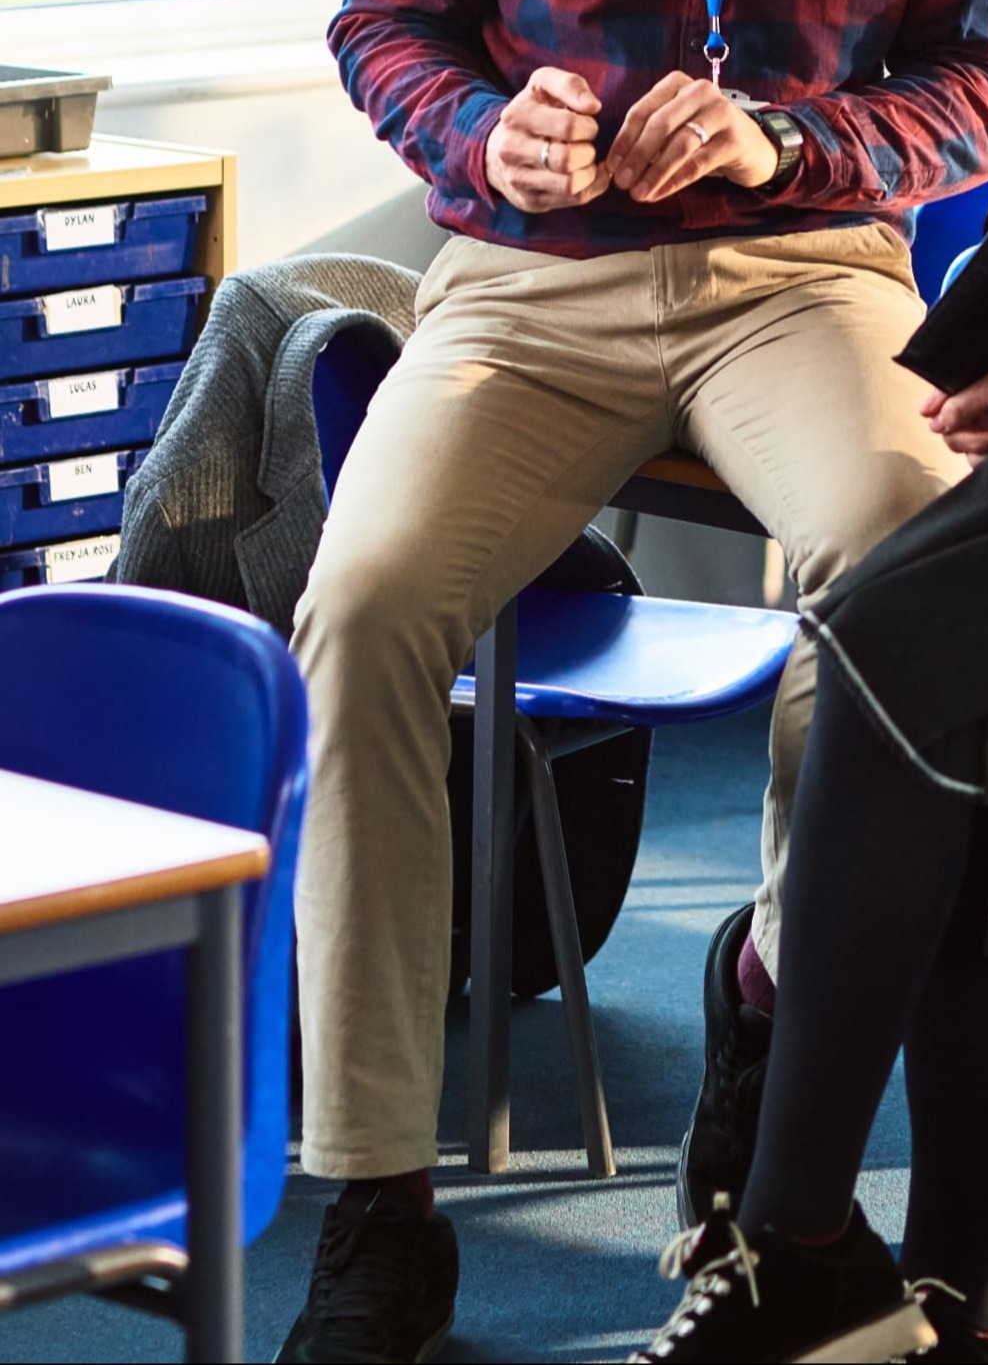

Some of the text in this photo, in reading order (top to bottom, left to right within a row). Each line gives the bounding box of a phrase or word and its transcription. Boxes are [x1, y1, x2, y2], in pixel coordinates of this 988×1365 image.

[65, 213, 95, 226] DYLAN
[66, 294, 96, 309] LAURA
[69, 381, 96, 394] LUCAS
[74, 464, 92, 475] BEN
[93, 543, 114, 557] ROSE
